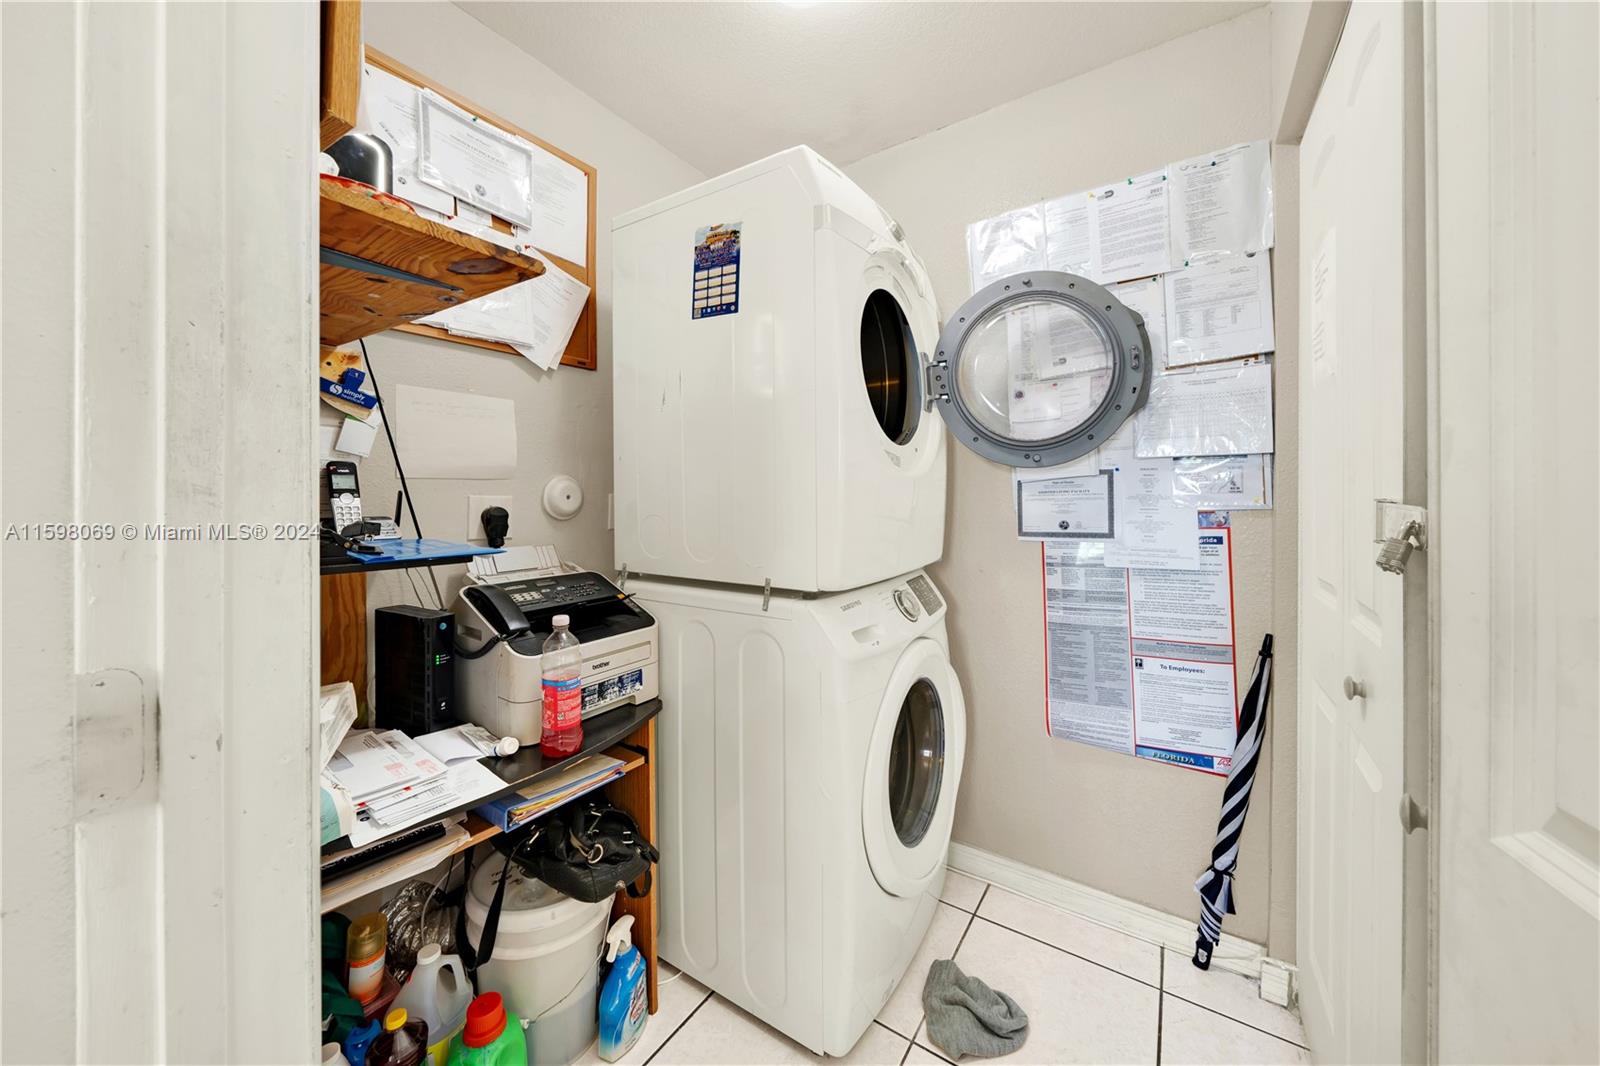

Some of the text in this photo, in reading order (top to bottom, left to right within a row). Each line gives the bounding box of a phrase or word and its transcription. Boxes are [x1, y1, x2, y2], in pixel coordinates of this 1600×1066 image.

[344, 389, 366, 401] simply
[592, 661, 610, 670] brother
[1168, 665, 1205, 674] Employees:
[1152, 751, 1195, 764] FLORIDA
